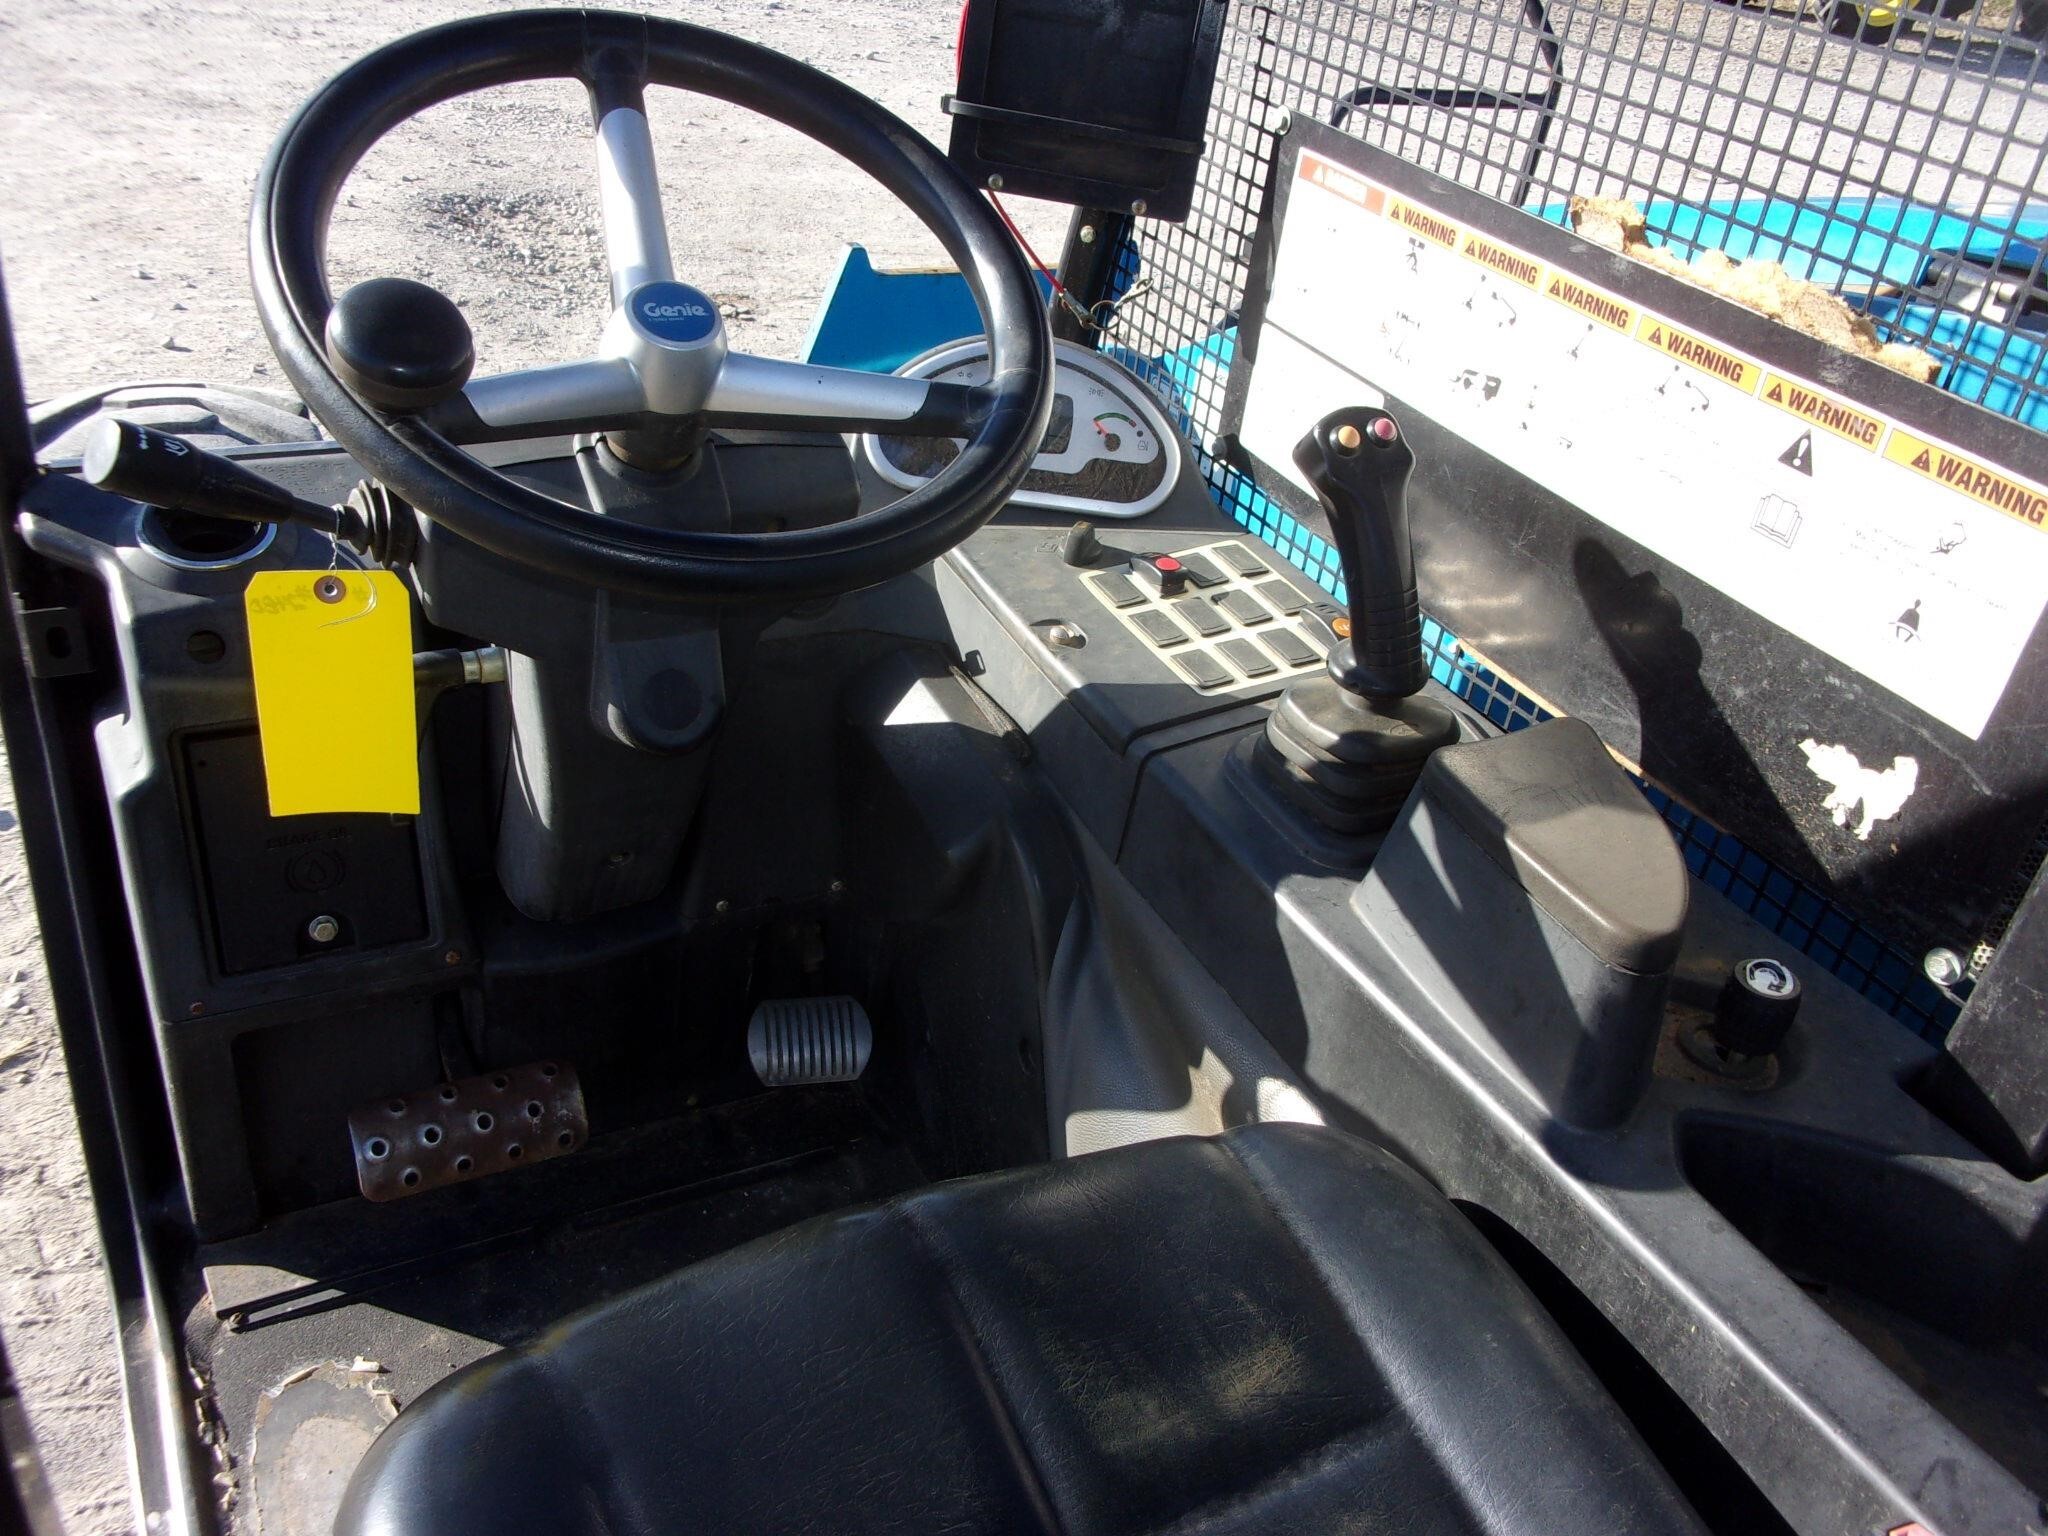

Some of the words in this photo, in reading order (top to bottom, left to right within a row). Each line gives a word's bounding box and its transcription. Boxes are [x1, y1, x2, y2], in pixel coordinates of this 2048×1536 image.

[1404, 206, 1456, 247] WARNING
[1477, 242, 1537, 285] WARNING
[644, 302, 707, 317] Genie
[1562, 282, 1628, 330] WARNING
[1667, 331, 1743, 384] WARNING
[1788, 388, 1877, 444] WARNING
[1936, 455, 2048, 525] WARNING
